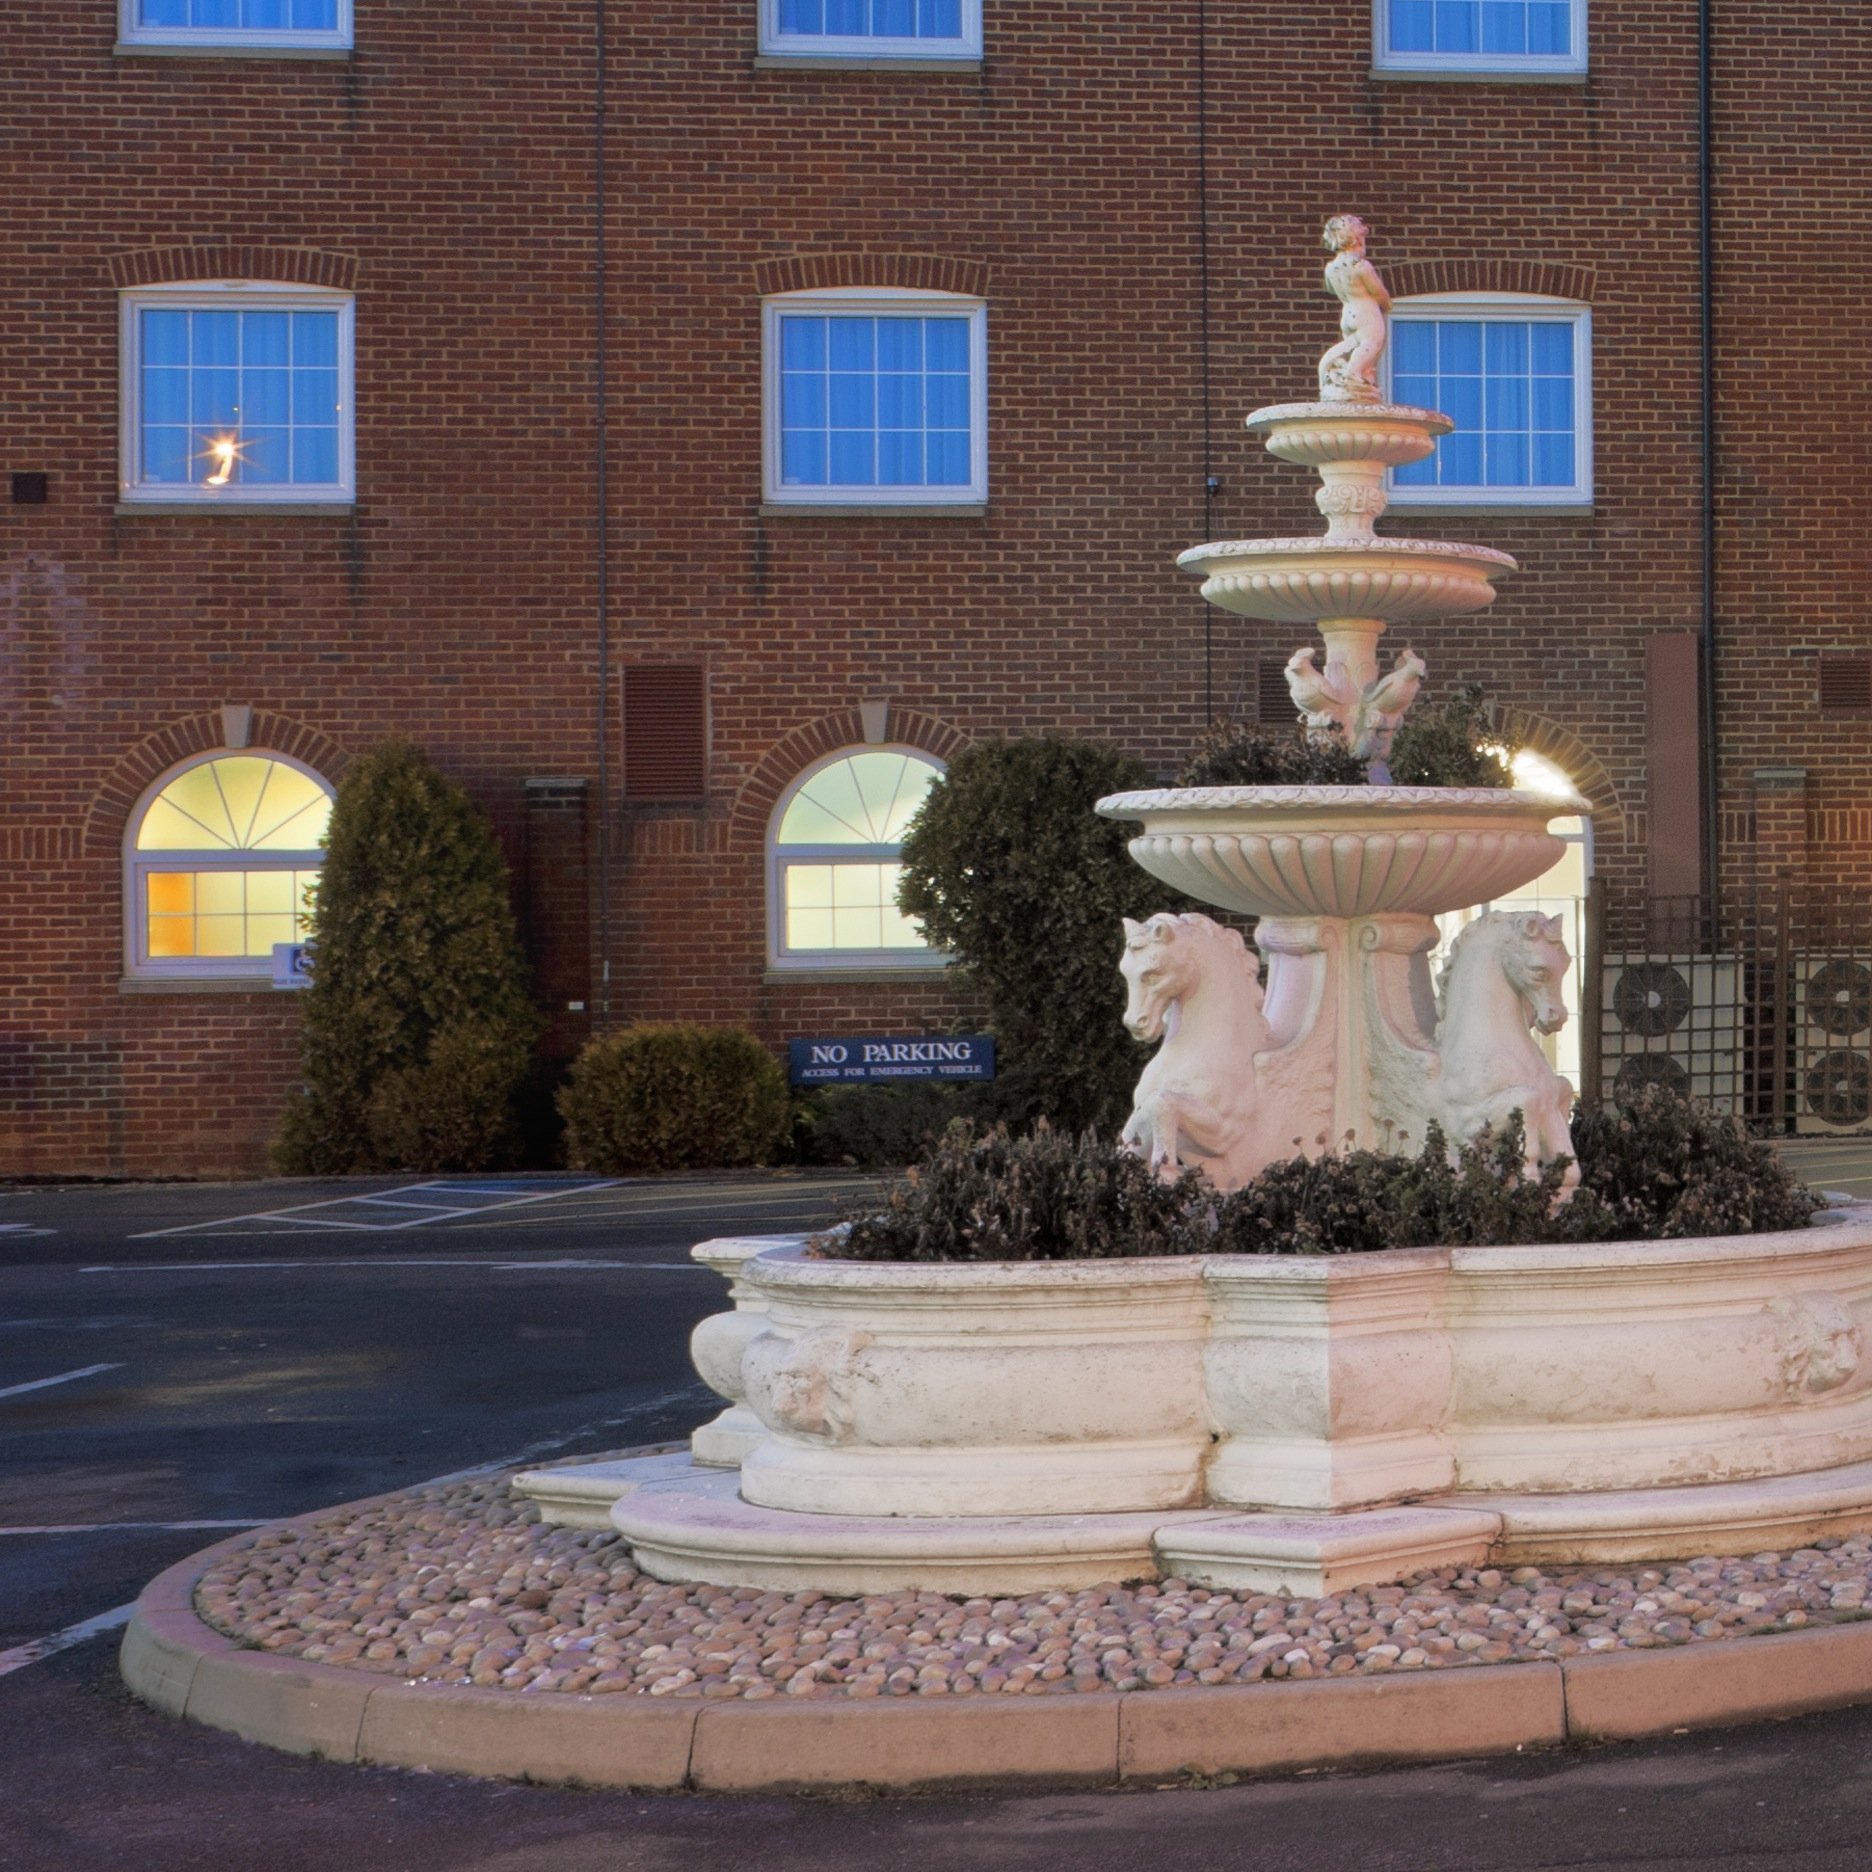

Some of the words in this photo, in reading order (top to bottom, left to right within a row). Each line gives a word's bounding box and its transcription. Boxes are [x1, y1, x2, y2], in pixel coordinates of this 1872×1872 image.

[811, 1045, 848, 1064] NO
[863, 1042, 972, 1062] PARKING
[801, 1068, 840, 1077] ACCESS
[844, 1067, 865, 1076] FOR
[870, 1066, 933, 1075] EMERGENCY
